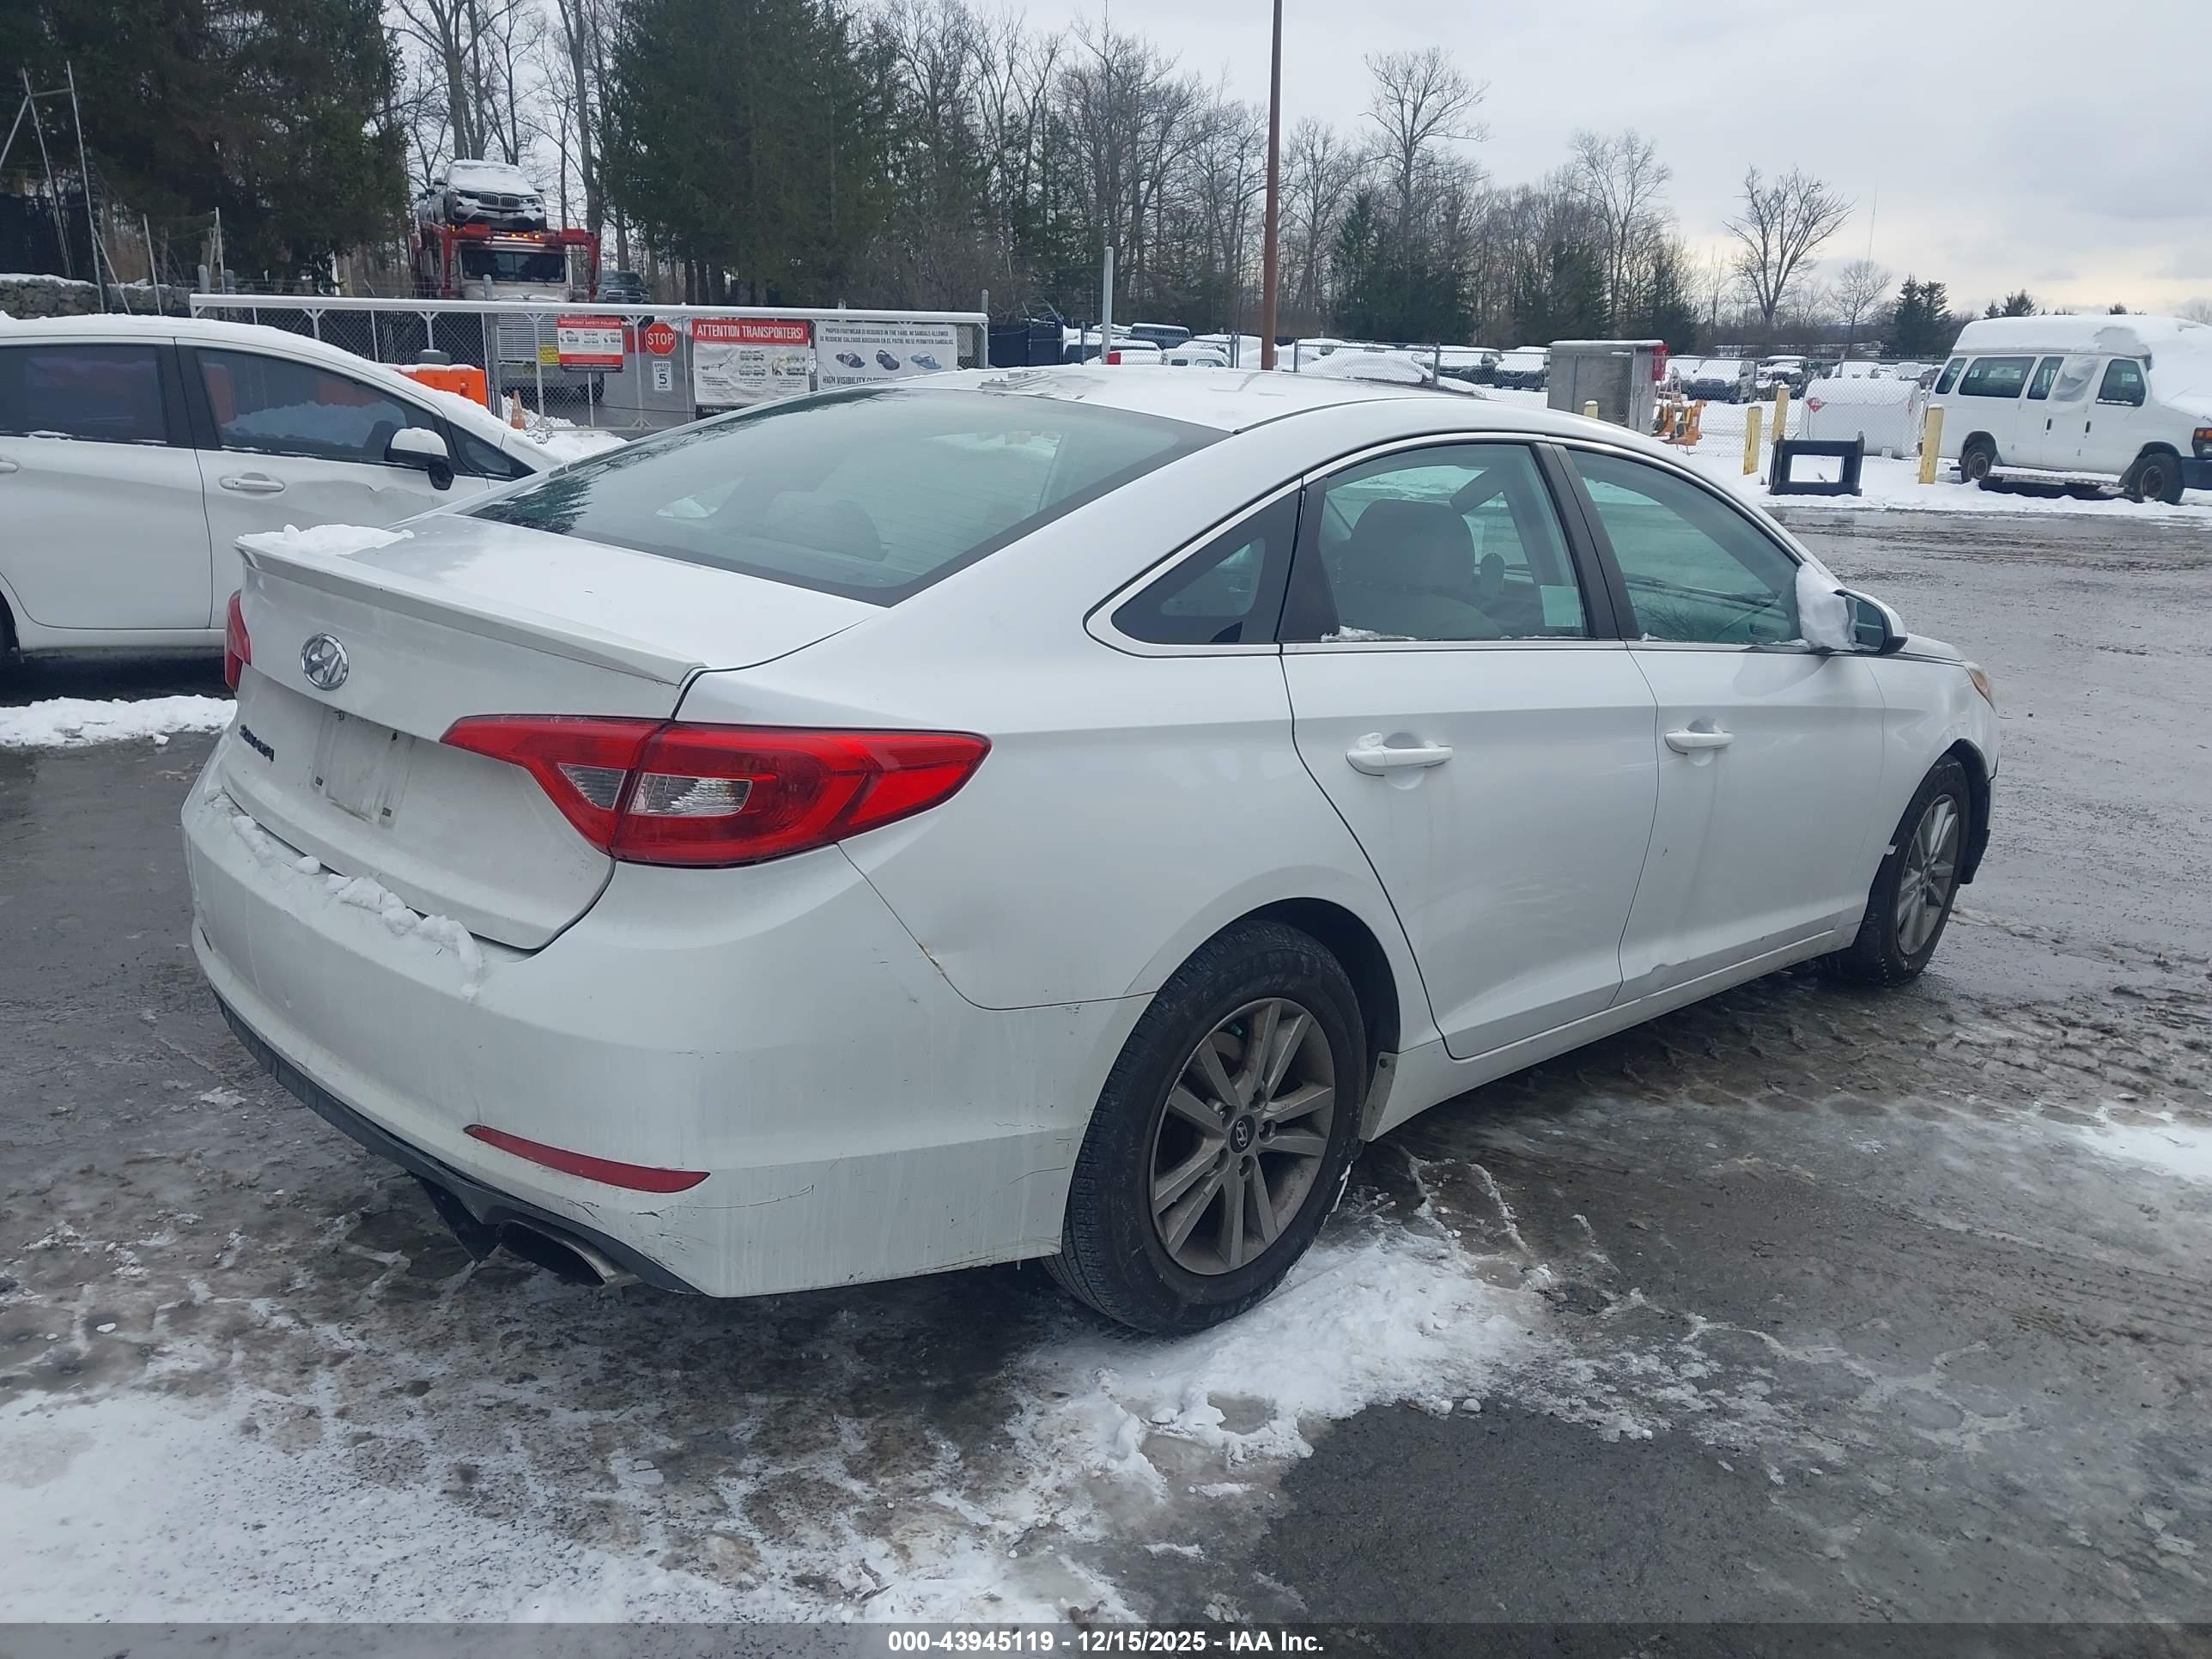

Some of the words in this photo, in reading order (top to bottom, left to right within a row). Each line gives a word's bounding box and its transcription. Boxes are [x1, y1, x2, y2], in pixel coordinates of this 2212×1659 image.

[696, 324, 740, 337] ATTENTION
[741, 325, 804, 339] TRANSPORTERS!
[647, 332, 674, 345] STOP
[659, 373, 667, 385] 5
[837, 376, 866, 385] VISIBILITY
